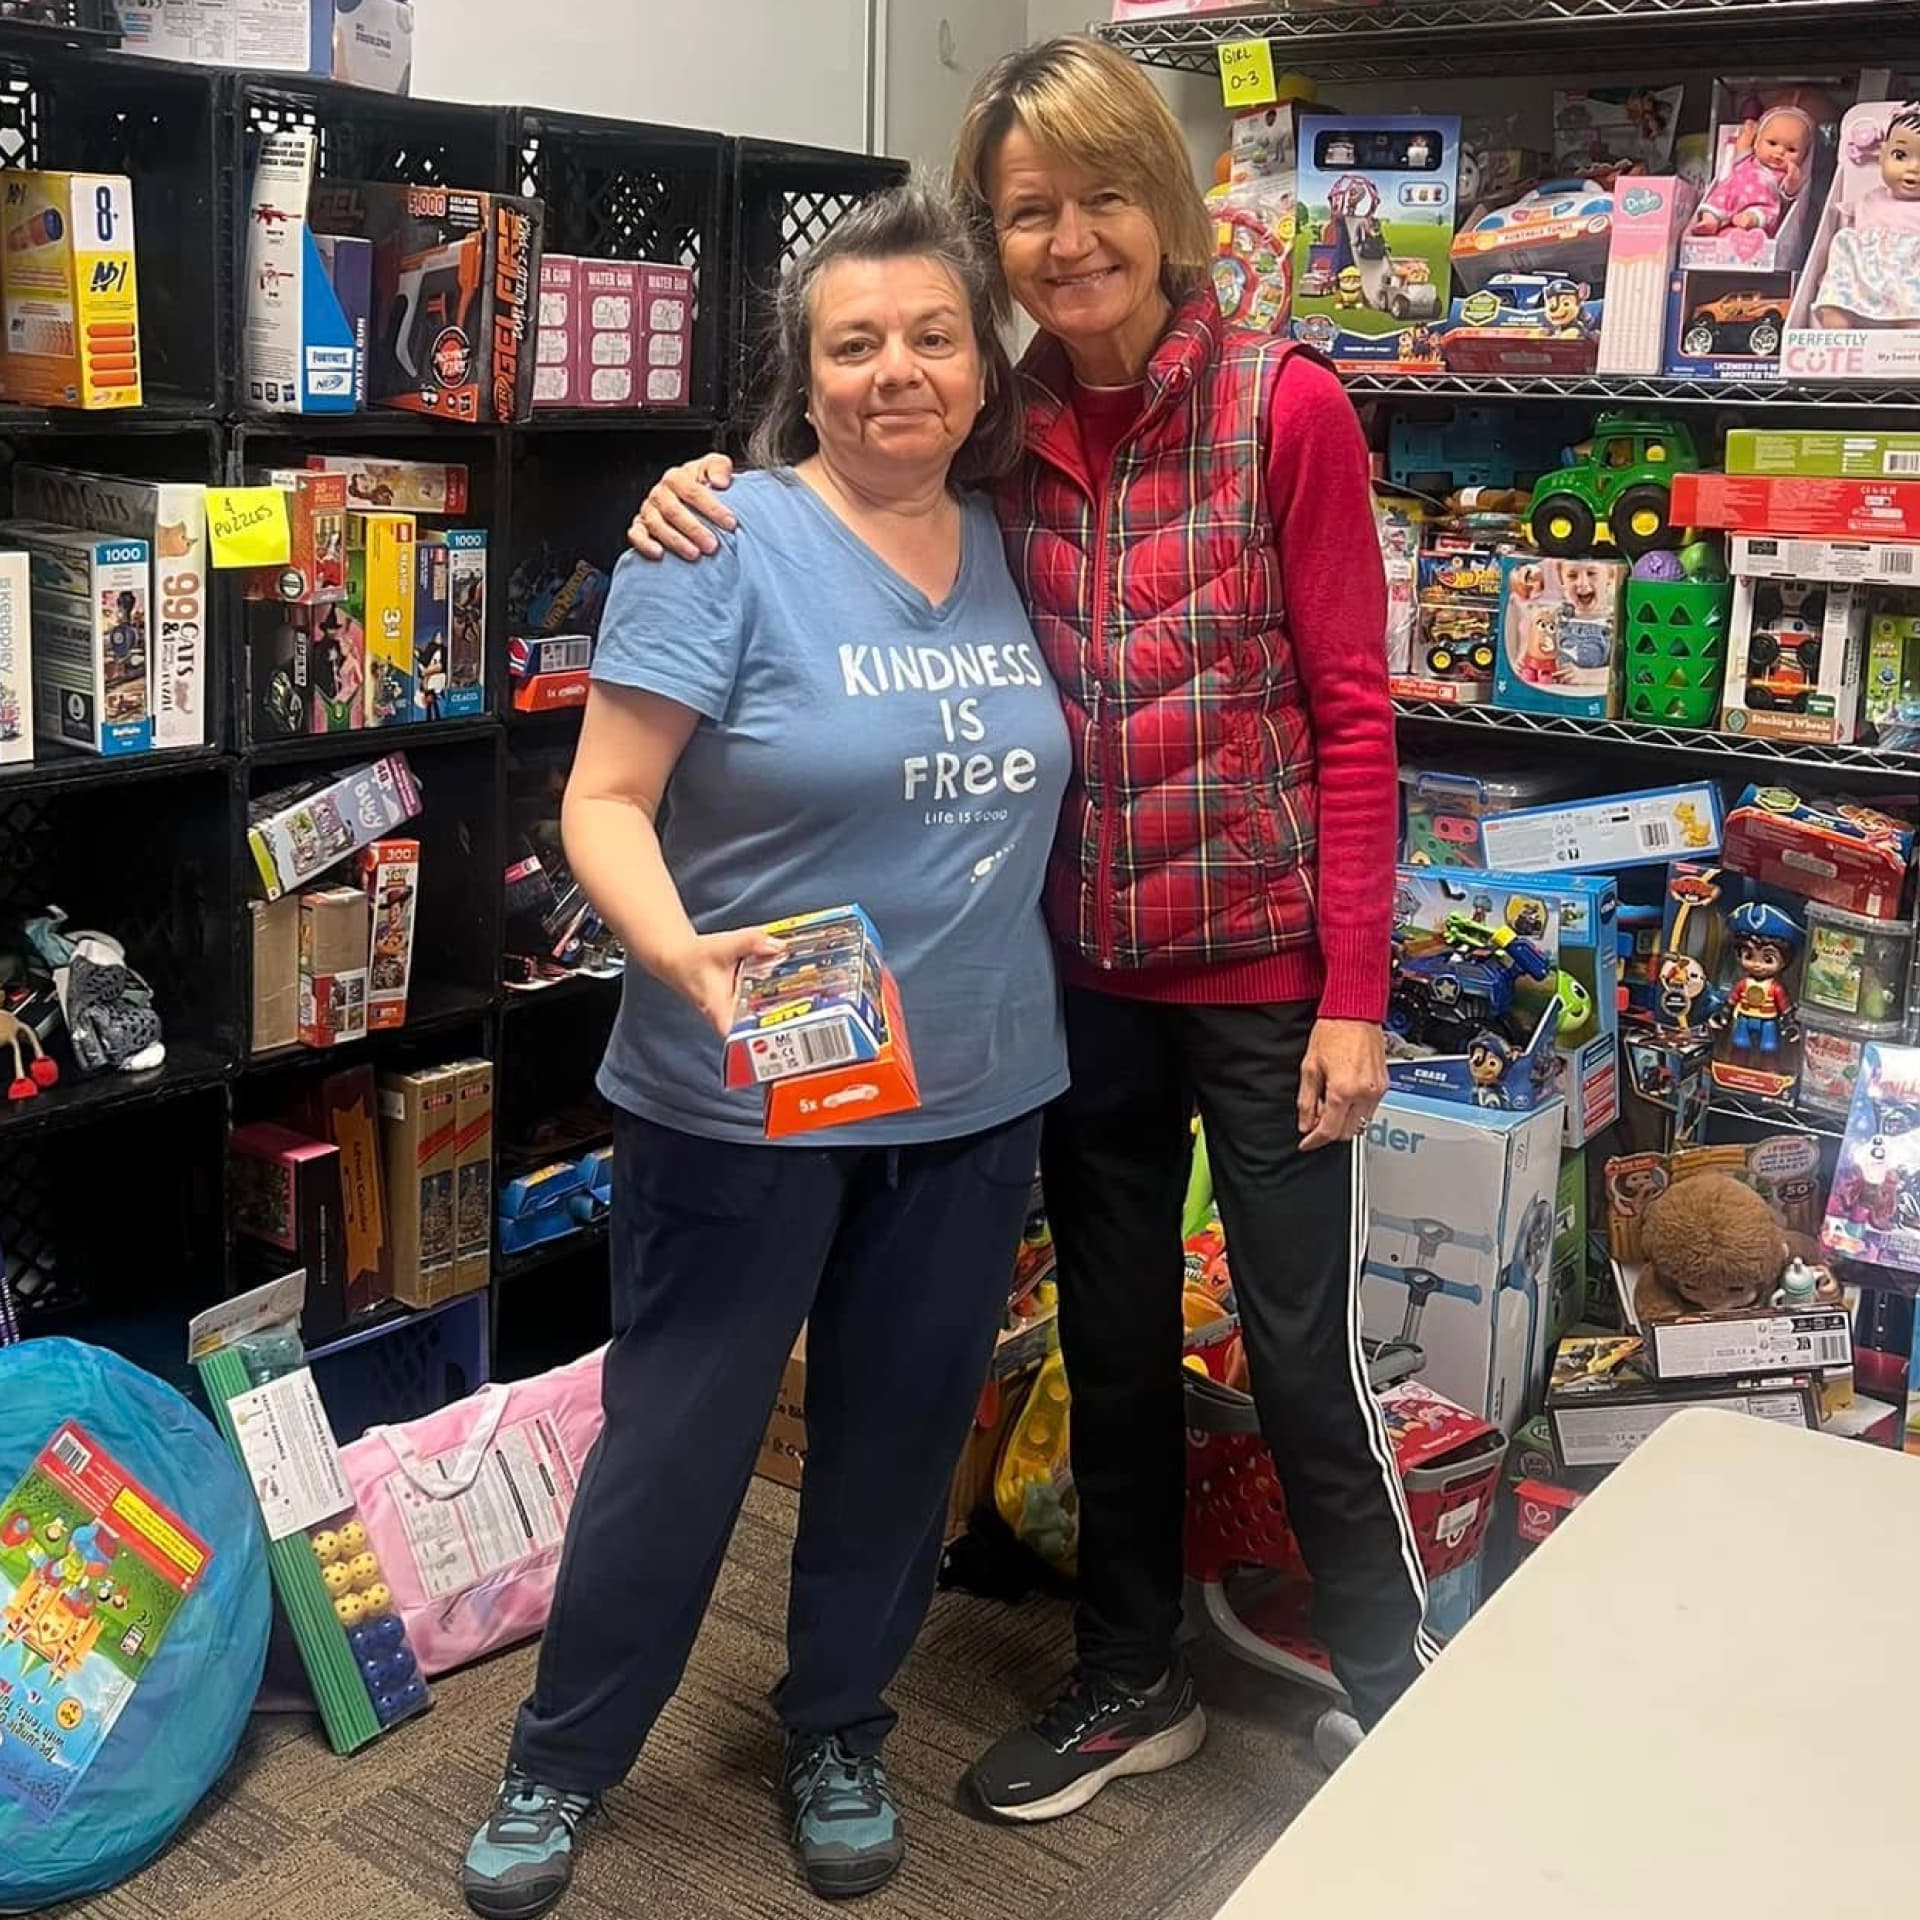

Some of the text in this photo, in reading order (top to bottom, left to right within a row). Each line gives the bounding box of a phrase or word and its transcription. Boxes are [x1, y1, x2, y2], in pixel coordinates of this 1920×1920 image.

[1222, 47, 1252, 64] GIRL
[1231, 70, 1260, 90] 0-3
[588, 272, 633, 287] WATER GUN
[648, 275, 688, 290] WATER GUN
[1788, 333, 1868, 346] PERFECTLY
[1786, 347, 1865, 373] CUTE
[214, 504, 273, 538] PUZZLES
[455, 535, 483, 547] 1000
[105, 547, 141, 561] 1000
[162, 572, 200, 677] 99 CATS
[838, 643, 1043, 697] KINDNESS
[939, 698, 985, 742] IS
[1751, 713, 1831, 732] Stacking Wheels
[354, 781, 384, 829] Bluey
[1414, 1069, 1448, 1081] CHASE
[800, 1099, 818, 1113] 5x
